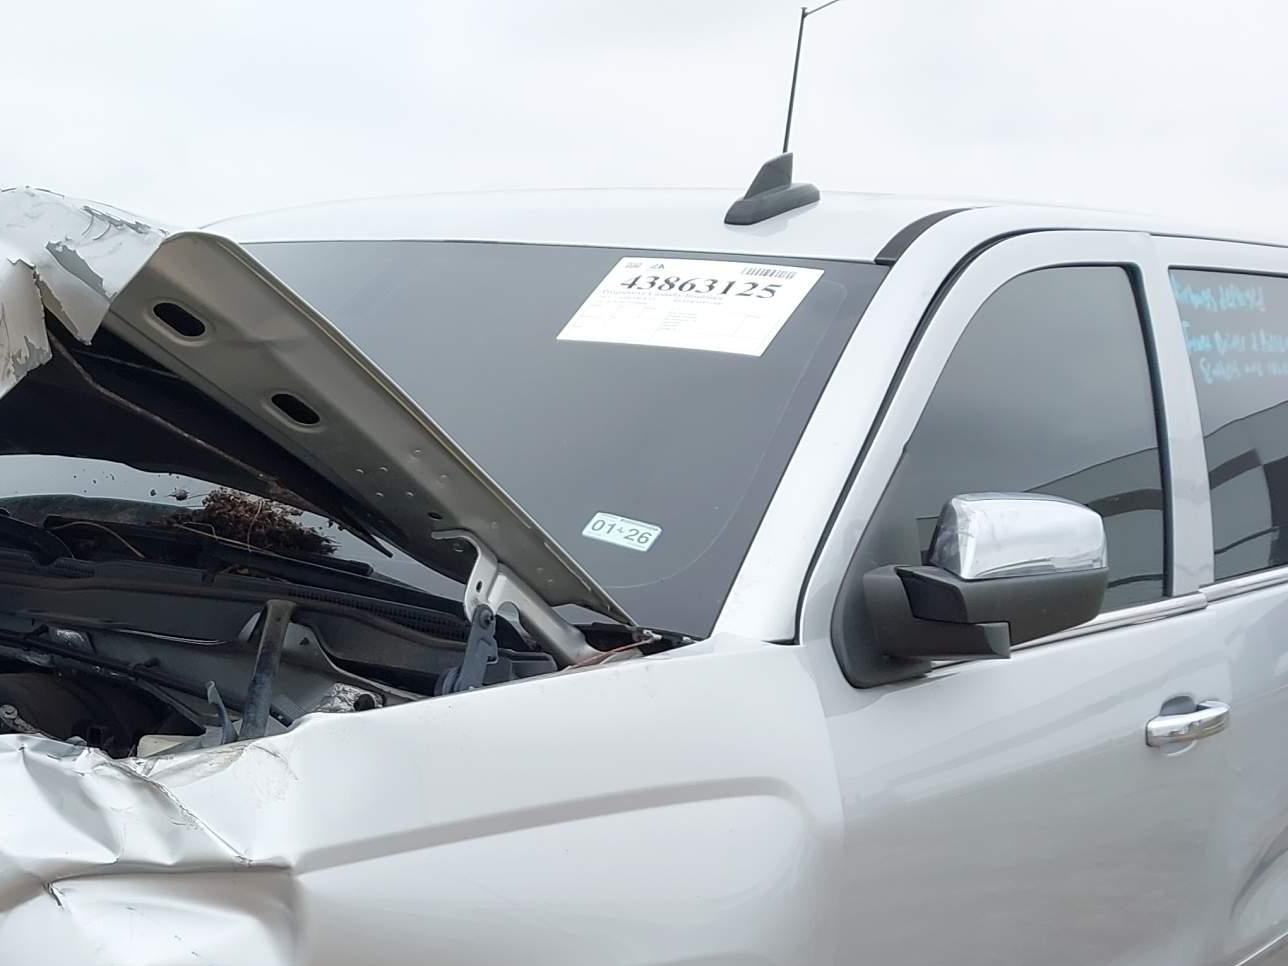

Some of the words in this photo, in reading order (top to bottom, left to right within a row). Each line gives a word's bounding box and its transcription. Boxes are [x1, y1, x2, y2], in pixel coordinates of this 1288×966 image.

[620, 274, 784, 299] 43863125
[591, 519, 617, 535] 01
[624, 528, 653, 544] 26
